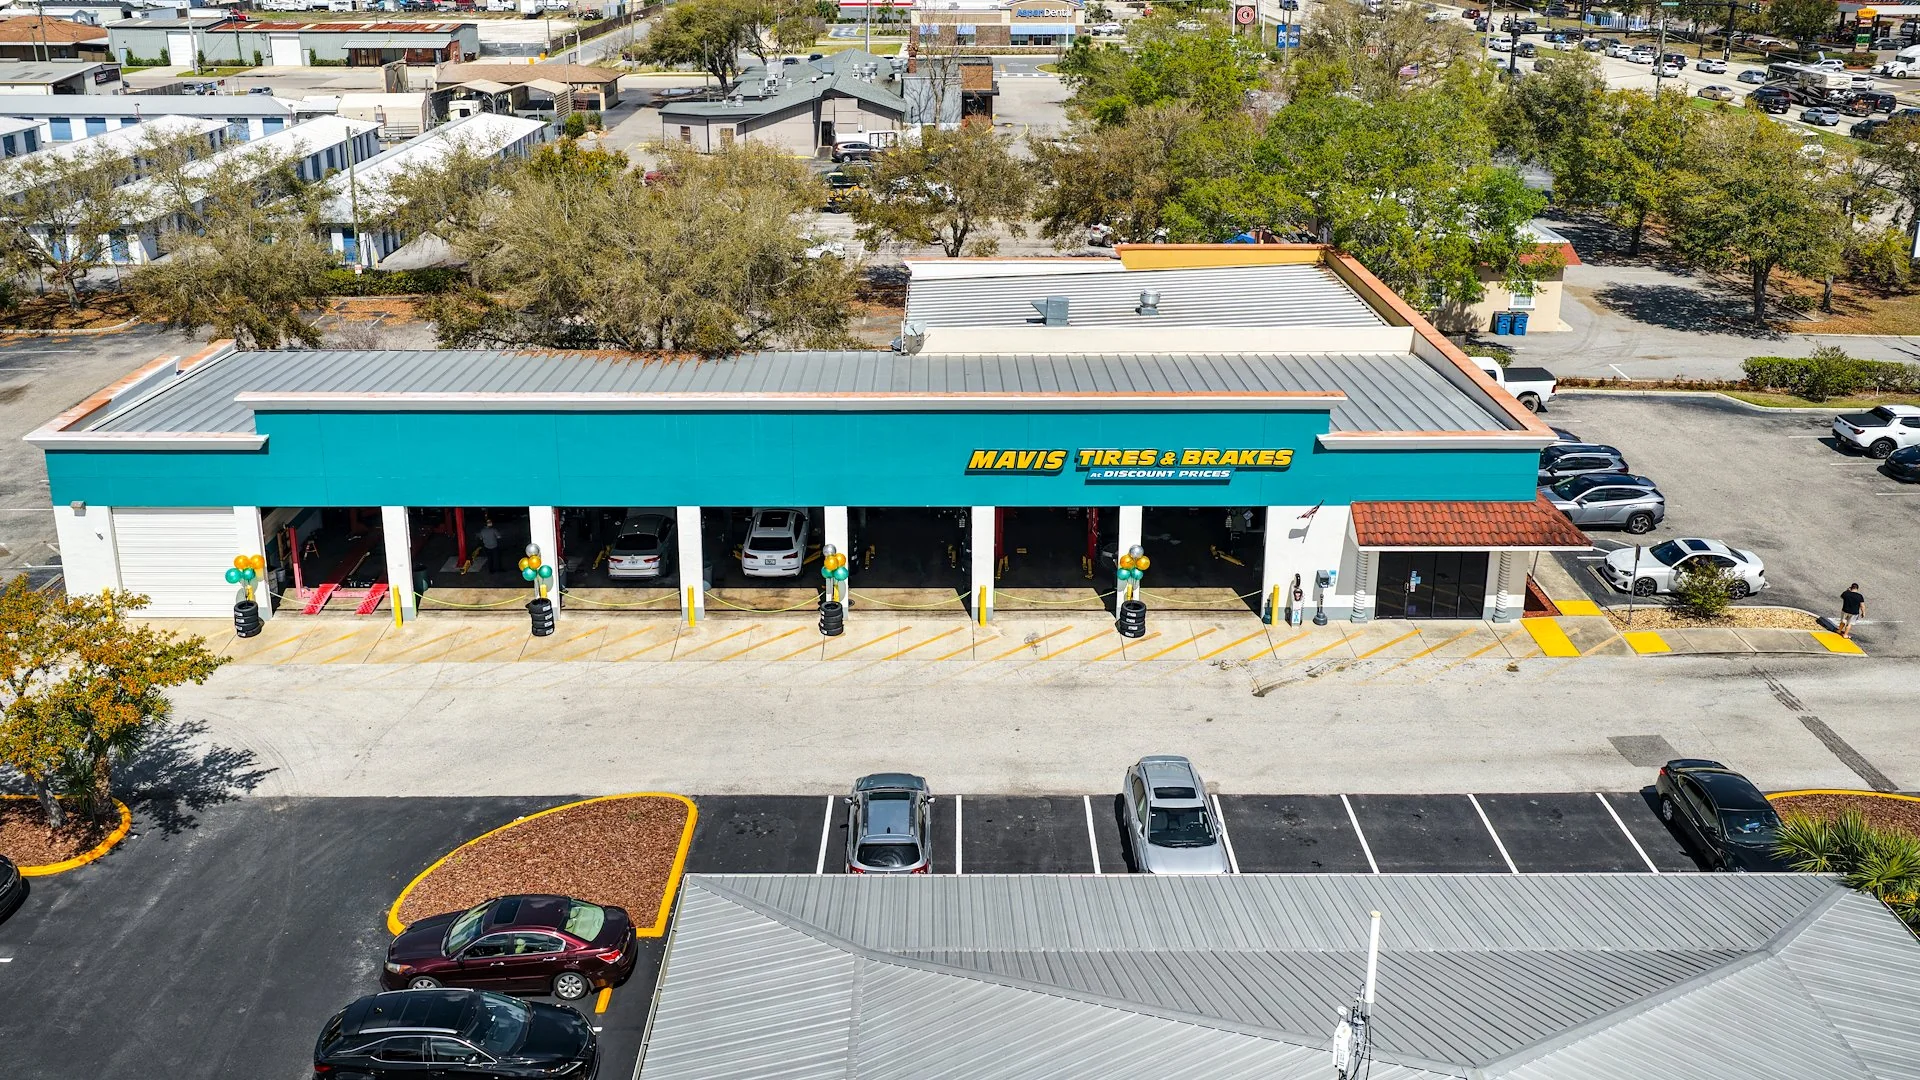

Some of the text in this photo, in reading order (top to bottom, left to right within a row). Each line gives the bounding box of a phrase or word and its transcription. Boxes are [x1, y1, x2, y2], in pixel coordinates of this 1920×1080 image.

[968, 450, 1294, 470] MAVIS TIRES & BRAKES
[1103, 470, 1176, 478] DISCOUNT
[1178, 470, 1231, 478] PRICES
